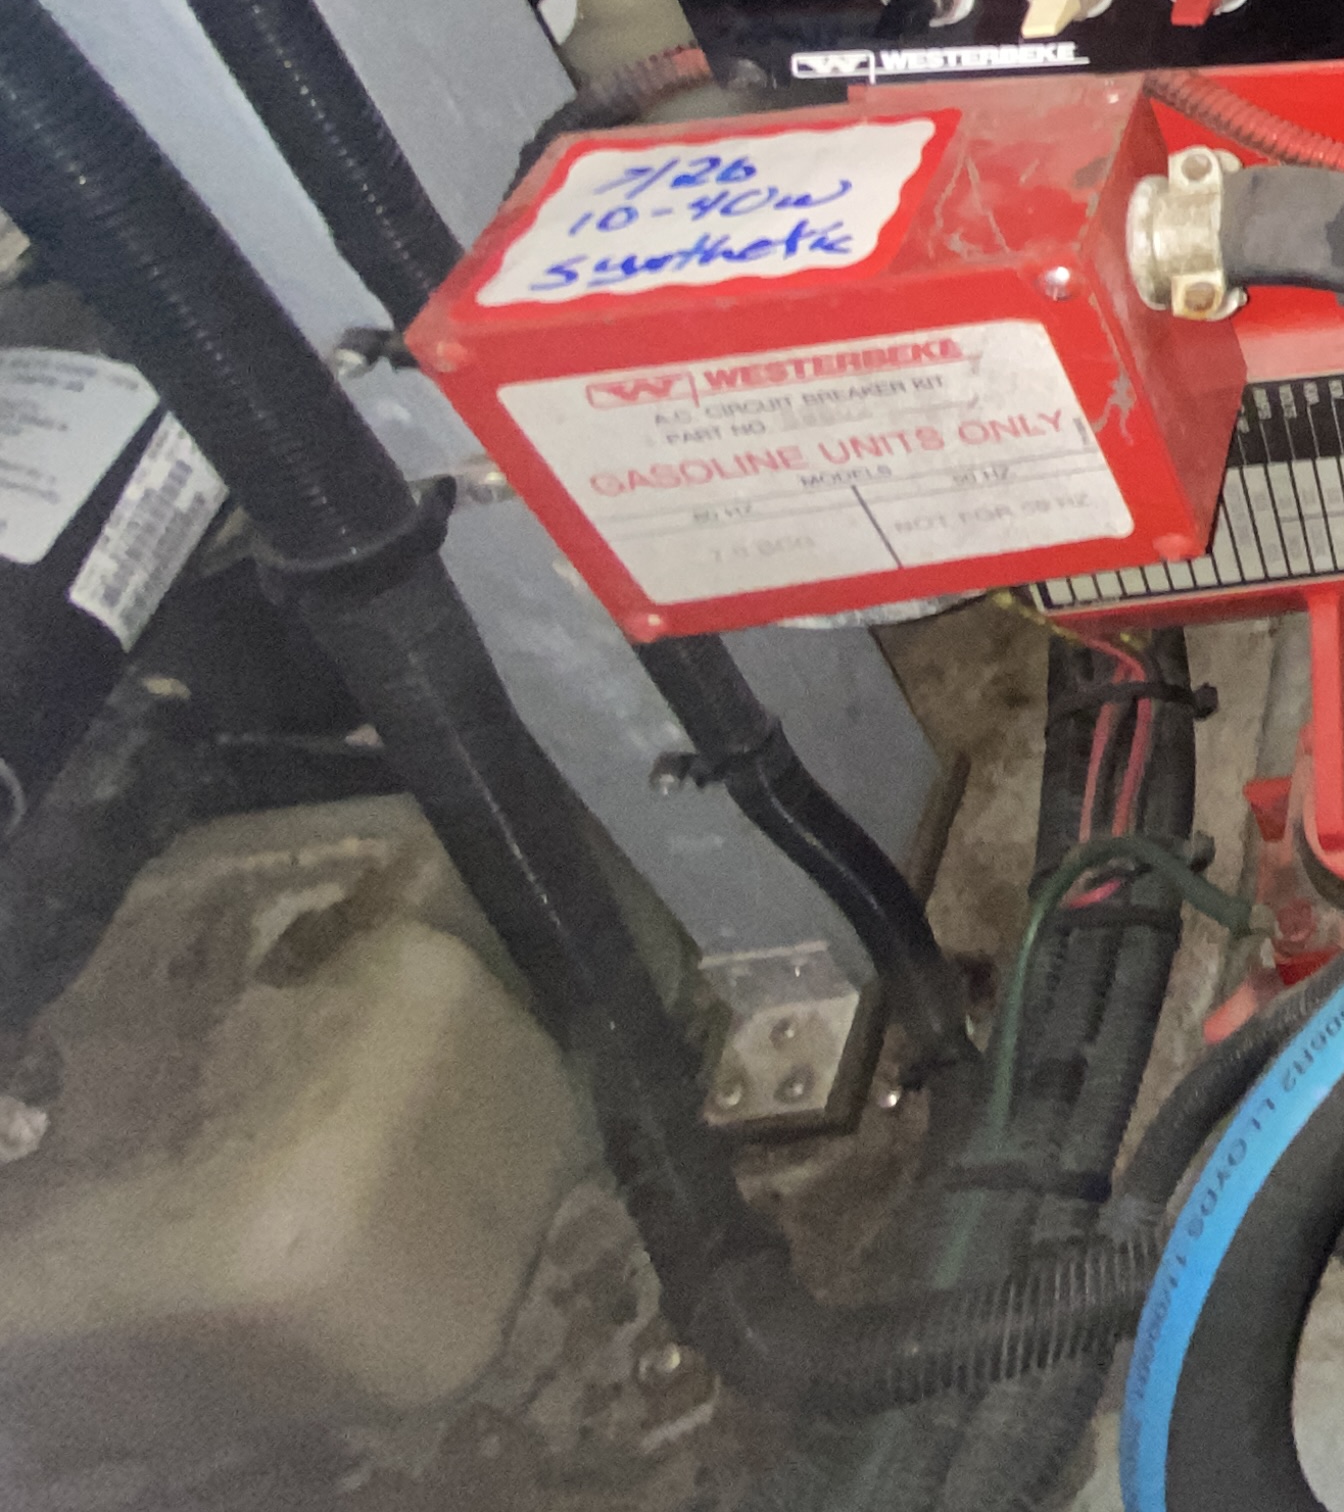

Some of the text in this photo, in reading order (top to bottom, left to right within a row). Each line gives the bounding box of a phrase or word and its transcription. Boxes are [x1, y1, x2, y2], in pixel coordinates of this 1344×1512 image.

[881, 42, 1076, 70] WESTERBEKE
[705, 395, 793, 420] CIRCUIT
[801, 379, 906, 407] BREAKER
[911, 375, 945, 391] KIT
[665, 426, 721, 445] PART
[589, 409, 1063, 497] GASOLINE UNITS ONLY
[800, 464, 893, 486] MODELS
[957, 505, 1015, 524] FOR
